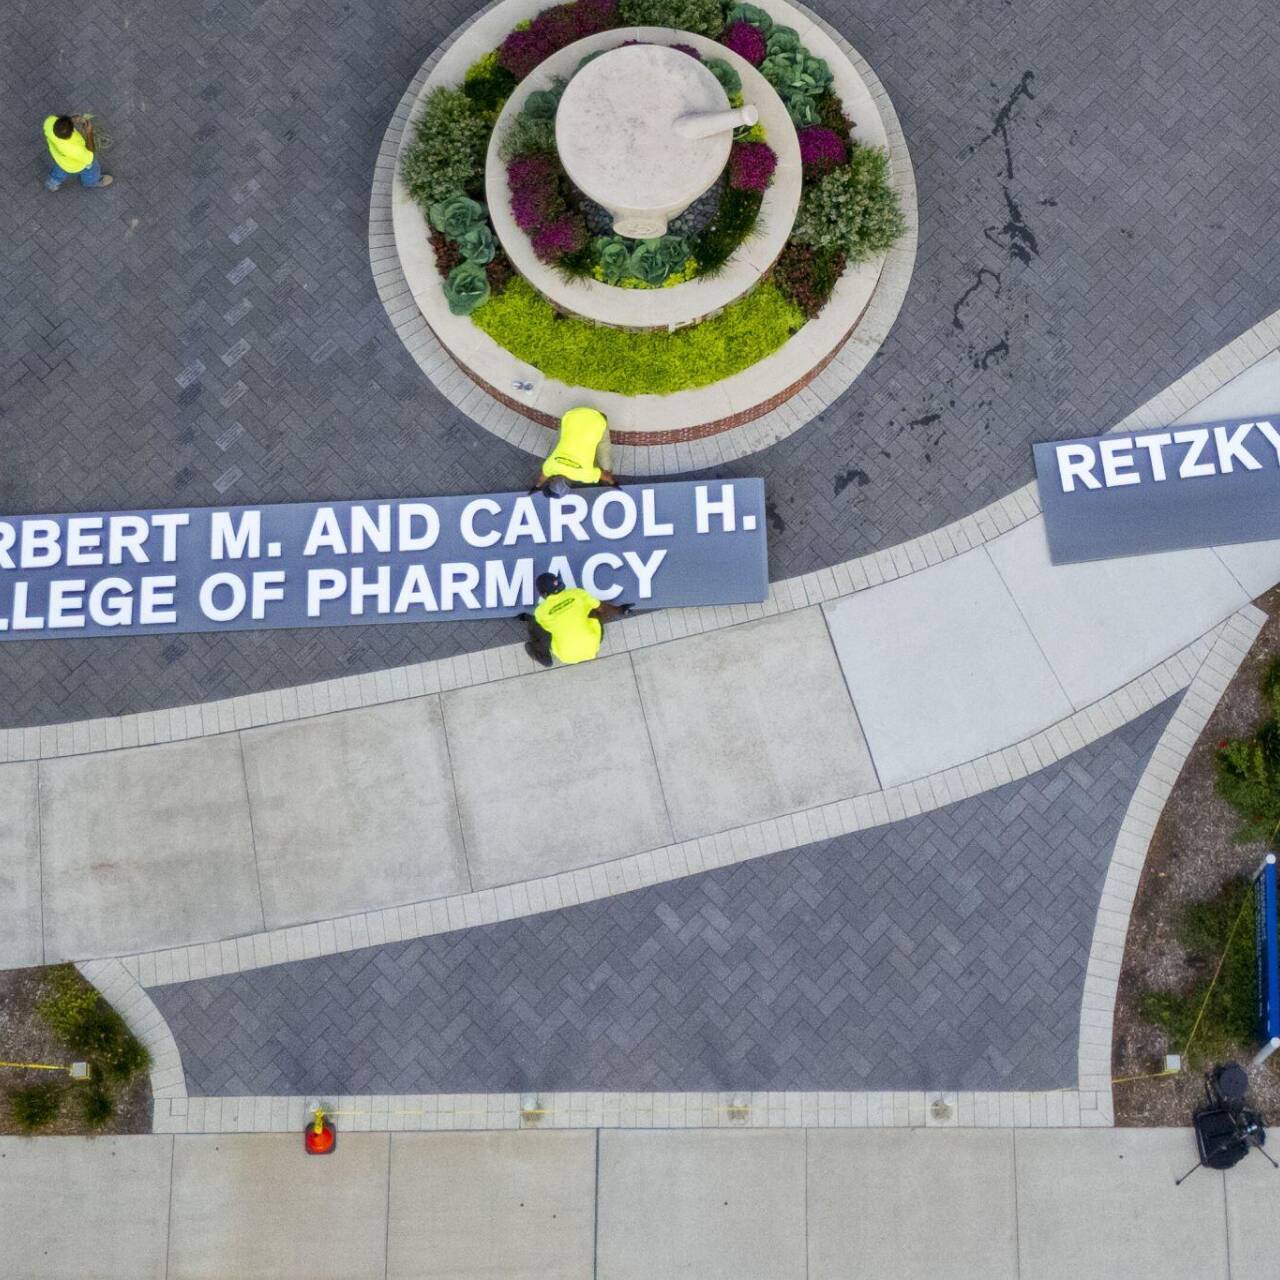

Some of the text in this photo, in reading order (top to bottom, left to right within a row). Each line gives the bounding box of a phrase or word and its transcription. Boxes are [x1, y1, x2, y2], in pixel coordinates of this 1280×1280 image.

[210, 510, 282, 560] M.
[303, 503, 440, 556] AND
[460, 488, 674, 548] CAROL
[695, 484, 756, 534] H.
[199, 570, 286, 622] OF
